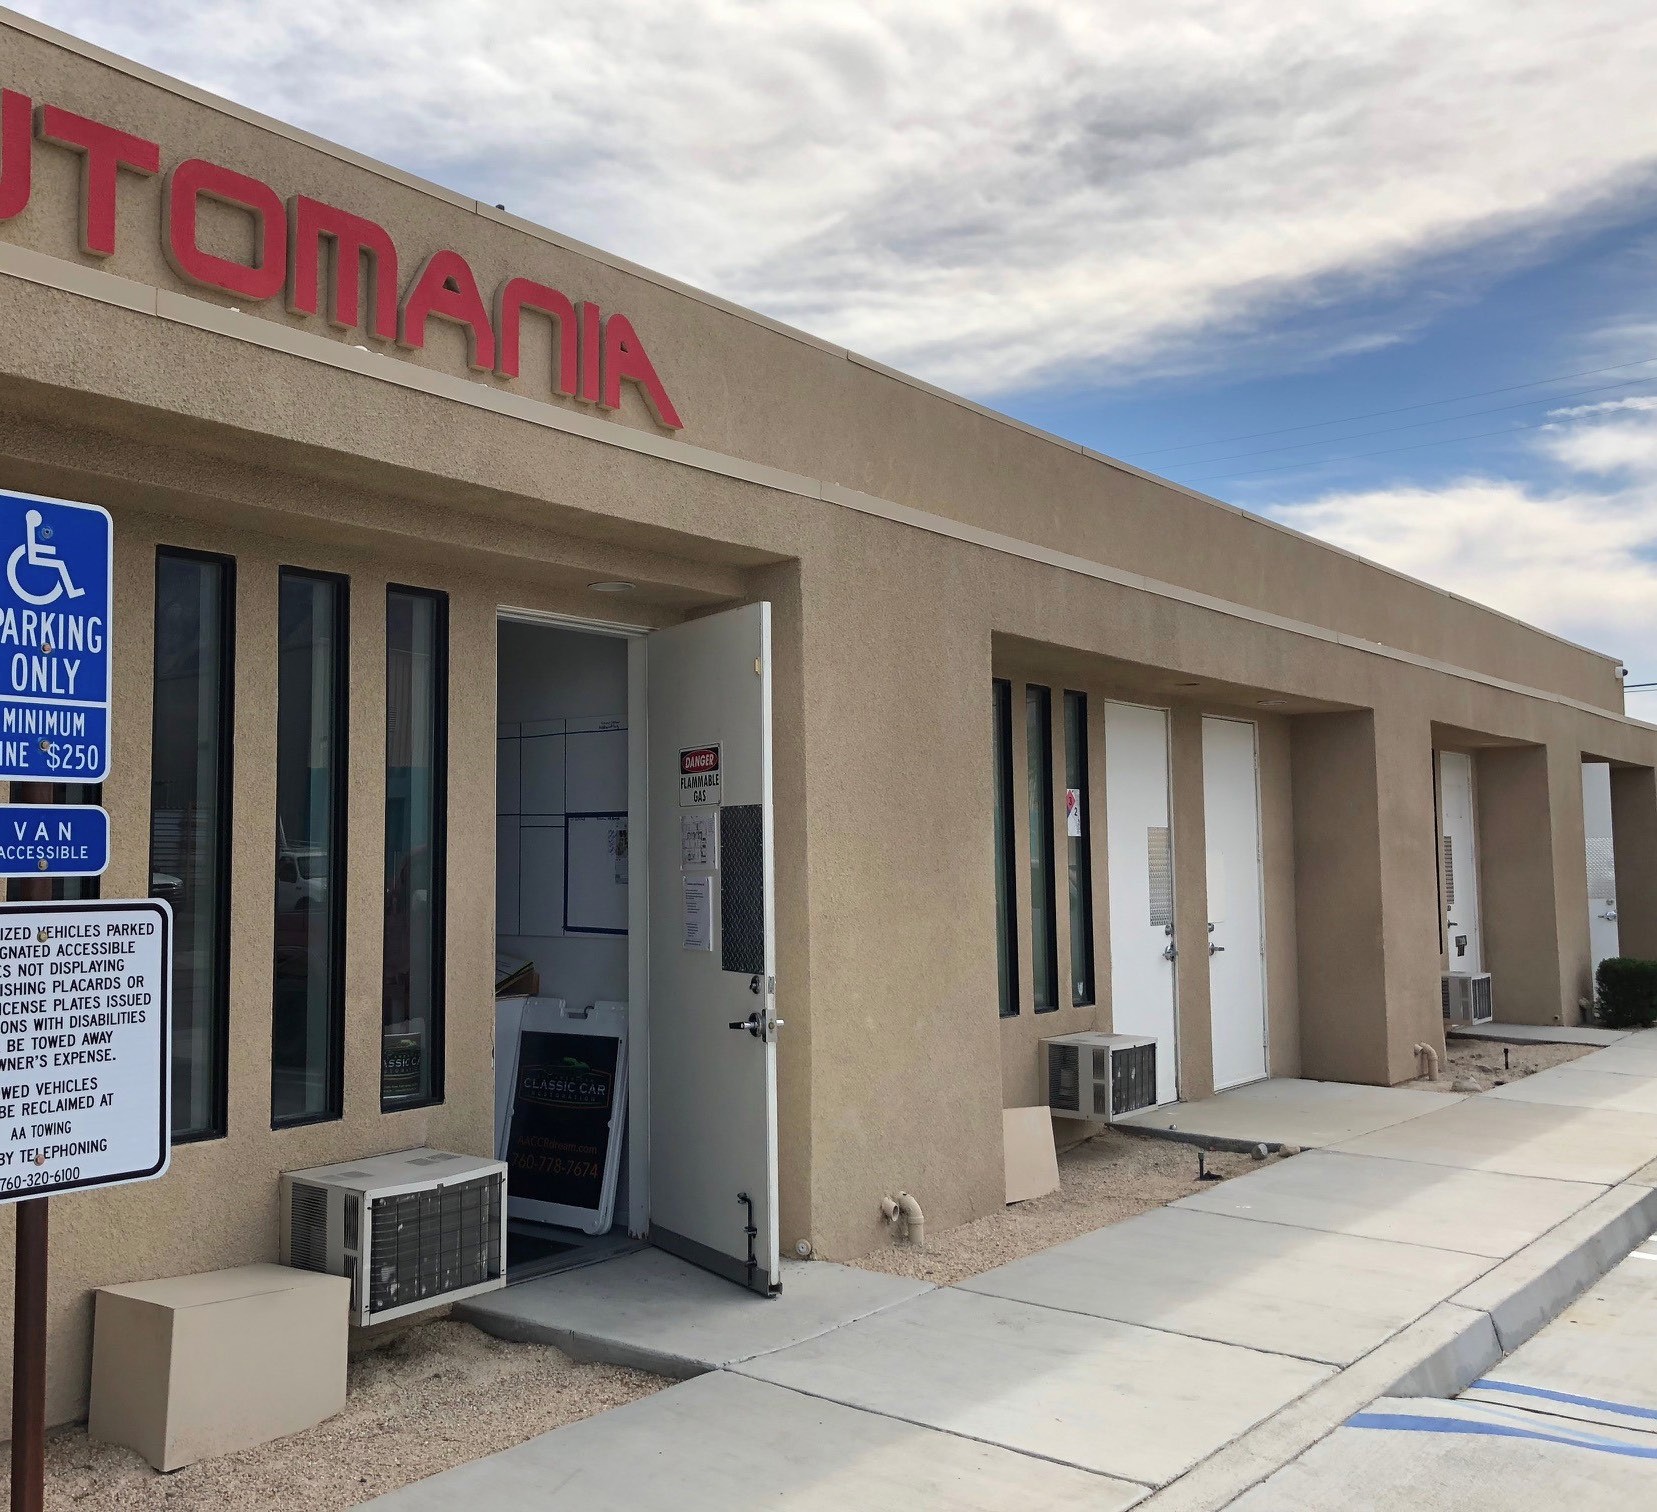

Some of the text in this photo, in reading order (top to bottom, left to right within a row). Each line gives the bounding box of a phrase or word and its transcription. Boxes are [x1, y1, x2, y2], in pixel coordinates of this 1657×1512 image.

[0, 86, 684, 430] TOMANIA
[11, 653, 81, 694] ONLY
[3, 707, 85, 737] MINIMUM
[47, 741, 99, 771] $250
[685, 753, 714, 769] DANGER
[681, 774, 719, 789] FLAMMABLE
[693, 790, 706, 802] GAS
[14, 821, 72, 841] VAN
[106, 922, 155, 938] PARKED
[0, 941, 136, 960] GNATED ACCESSIBLE
[0, 958, 125, 978] S NOT DISPLAYING
[0, 975, 145, 997] ISHING PLACARDS OR
[54, 995, 101, 1012] PLATES
[107, 993, 152, 1008] ISSUED
[0, 1010, 146, 1034] ONS WITH DISABILITIES
[7, 1030, 113, 1052] BE TOWED AWAY
[54, 1048, 116, 1067] EXPENSE.
[1, 1077, 98, 1100] WED VEHICLES
[524, 1078, 576, 1093] CLASSIC
[580, 1083, 606, 1096] CAR
[0, 1093, 114, 1119] BE RECLAIMED AT
[11, 1121, 72, 1141] AA TOWING
[0, 1166, 81, 1191] 760-320-6100
